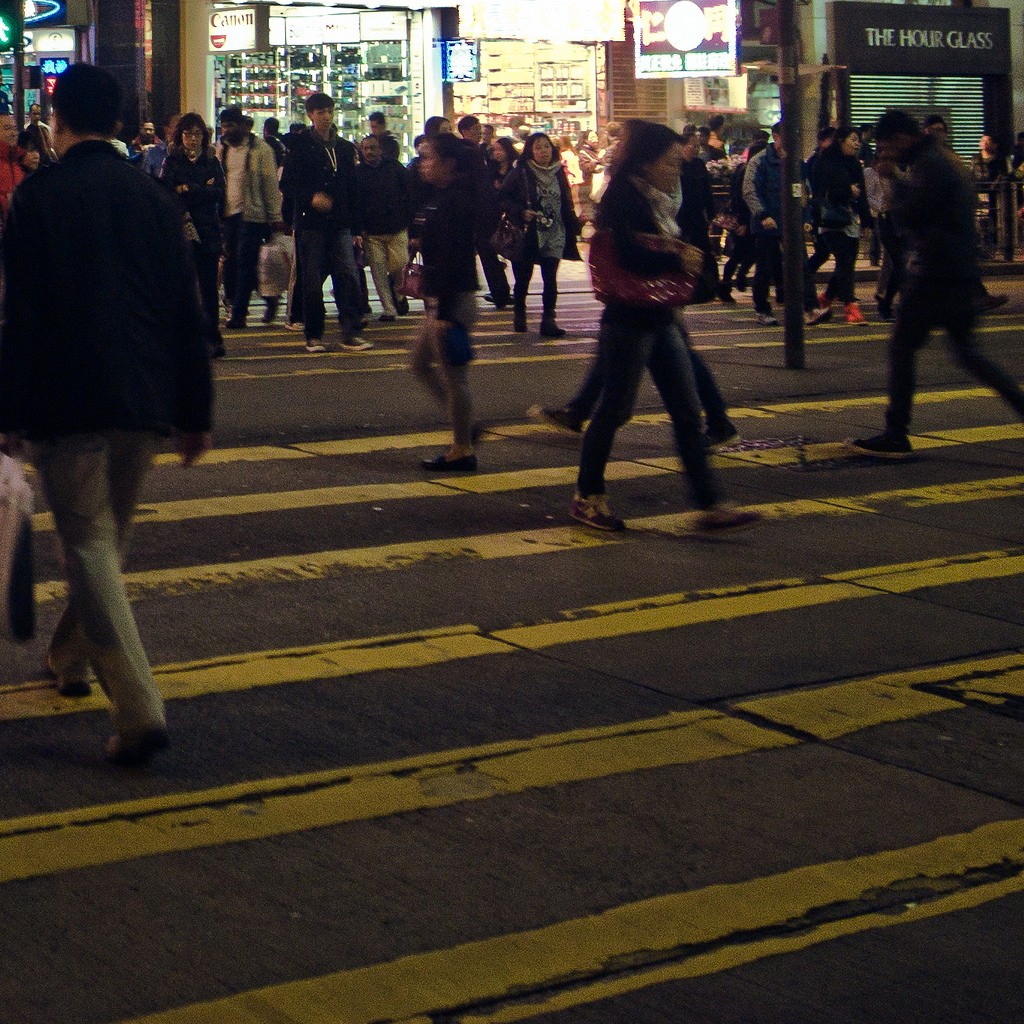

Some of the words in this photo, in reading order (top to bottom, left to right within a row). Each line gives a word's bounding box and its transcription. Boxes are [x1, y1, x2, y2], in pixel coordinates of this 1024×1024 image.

[210, 12, 254, 28] Canon
[865, 27, 895, 47] THE
[898, 29, 945, 48] HOUR
[946, 30, 994, 50] GLASS
